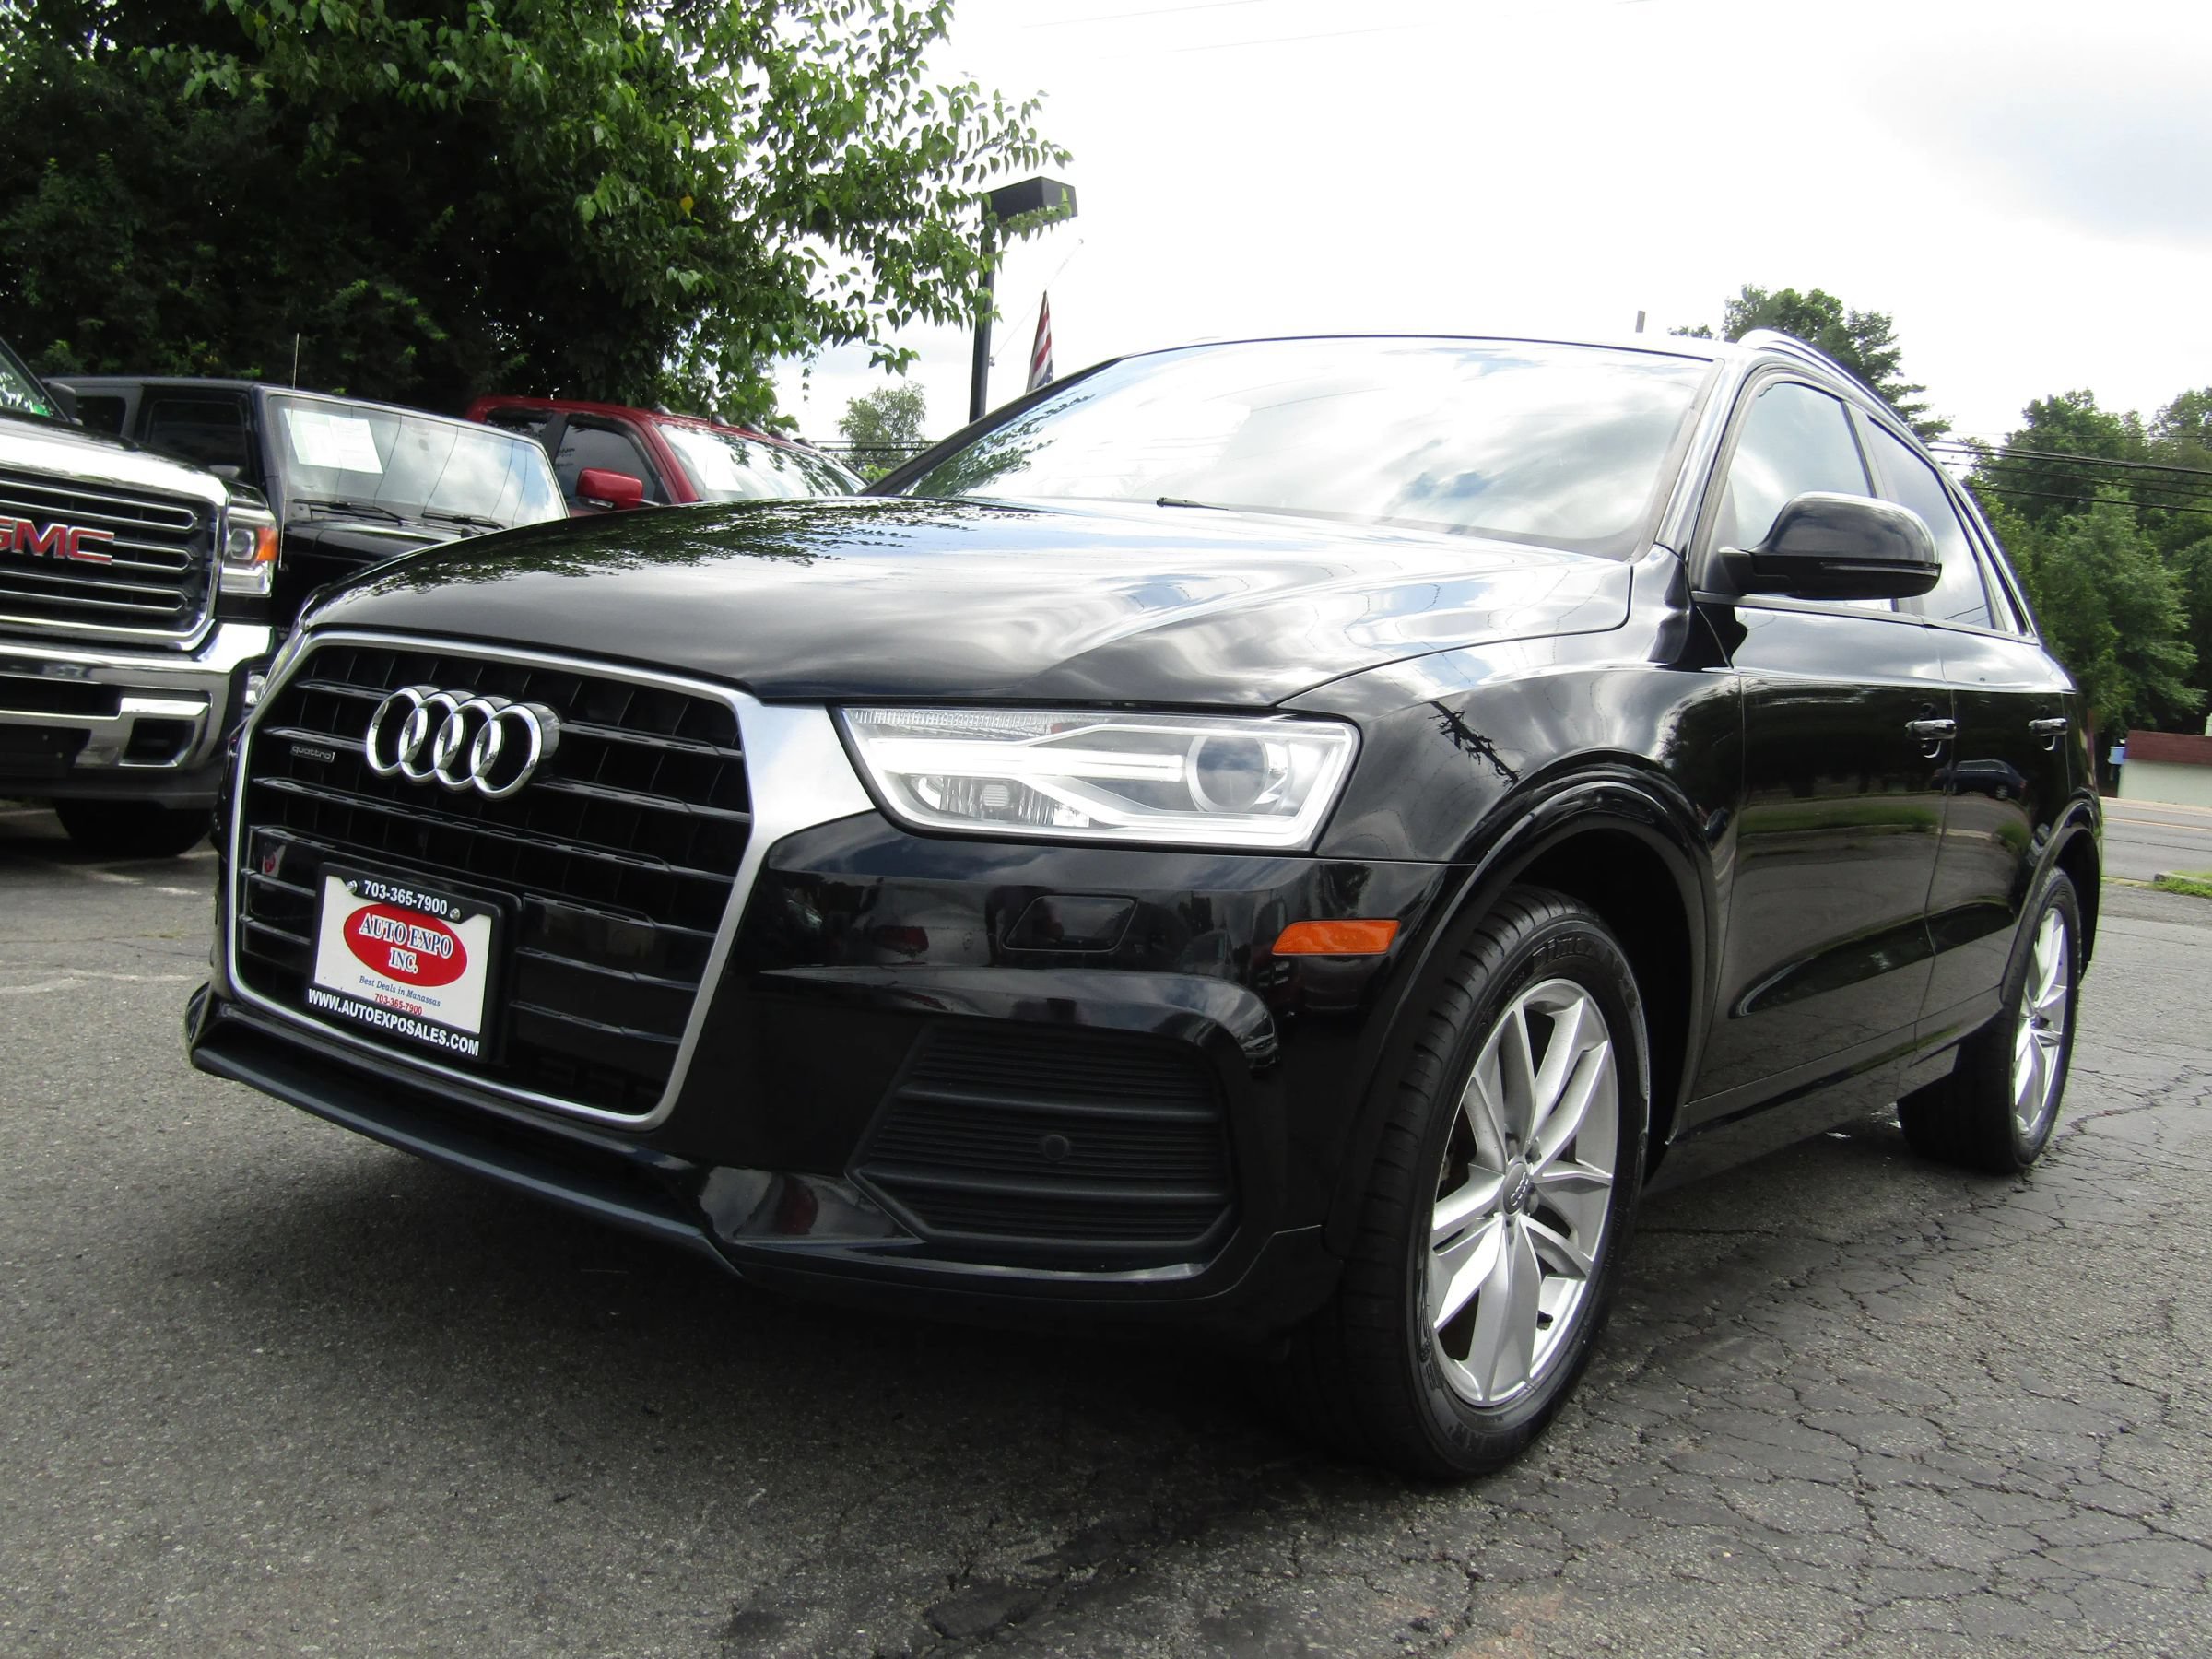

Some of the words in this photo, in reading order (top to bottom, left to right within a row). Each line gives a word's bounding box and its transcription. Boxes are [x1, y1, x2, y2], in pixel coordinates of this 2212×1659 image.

[0, 515, 115, 565] MC
[291, 745, 332, 760] quattro
[364, 880, 448, 915] 703-365-7900
[359, 912, 407, 944] AUTO
[409, 924, 453, 959] EXPO
[388, 947, 418, 974] INC.
[359, 975, 375, 987] Best
[376, 979, 396, 993] Deals
[397, 986, 406, 995] in
[374, 993, 423, 1015] 703-365-7900
[308, 988, 479, 1056] WWW.AUTOEXPOSALES.COM
